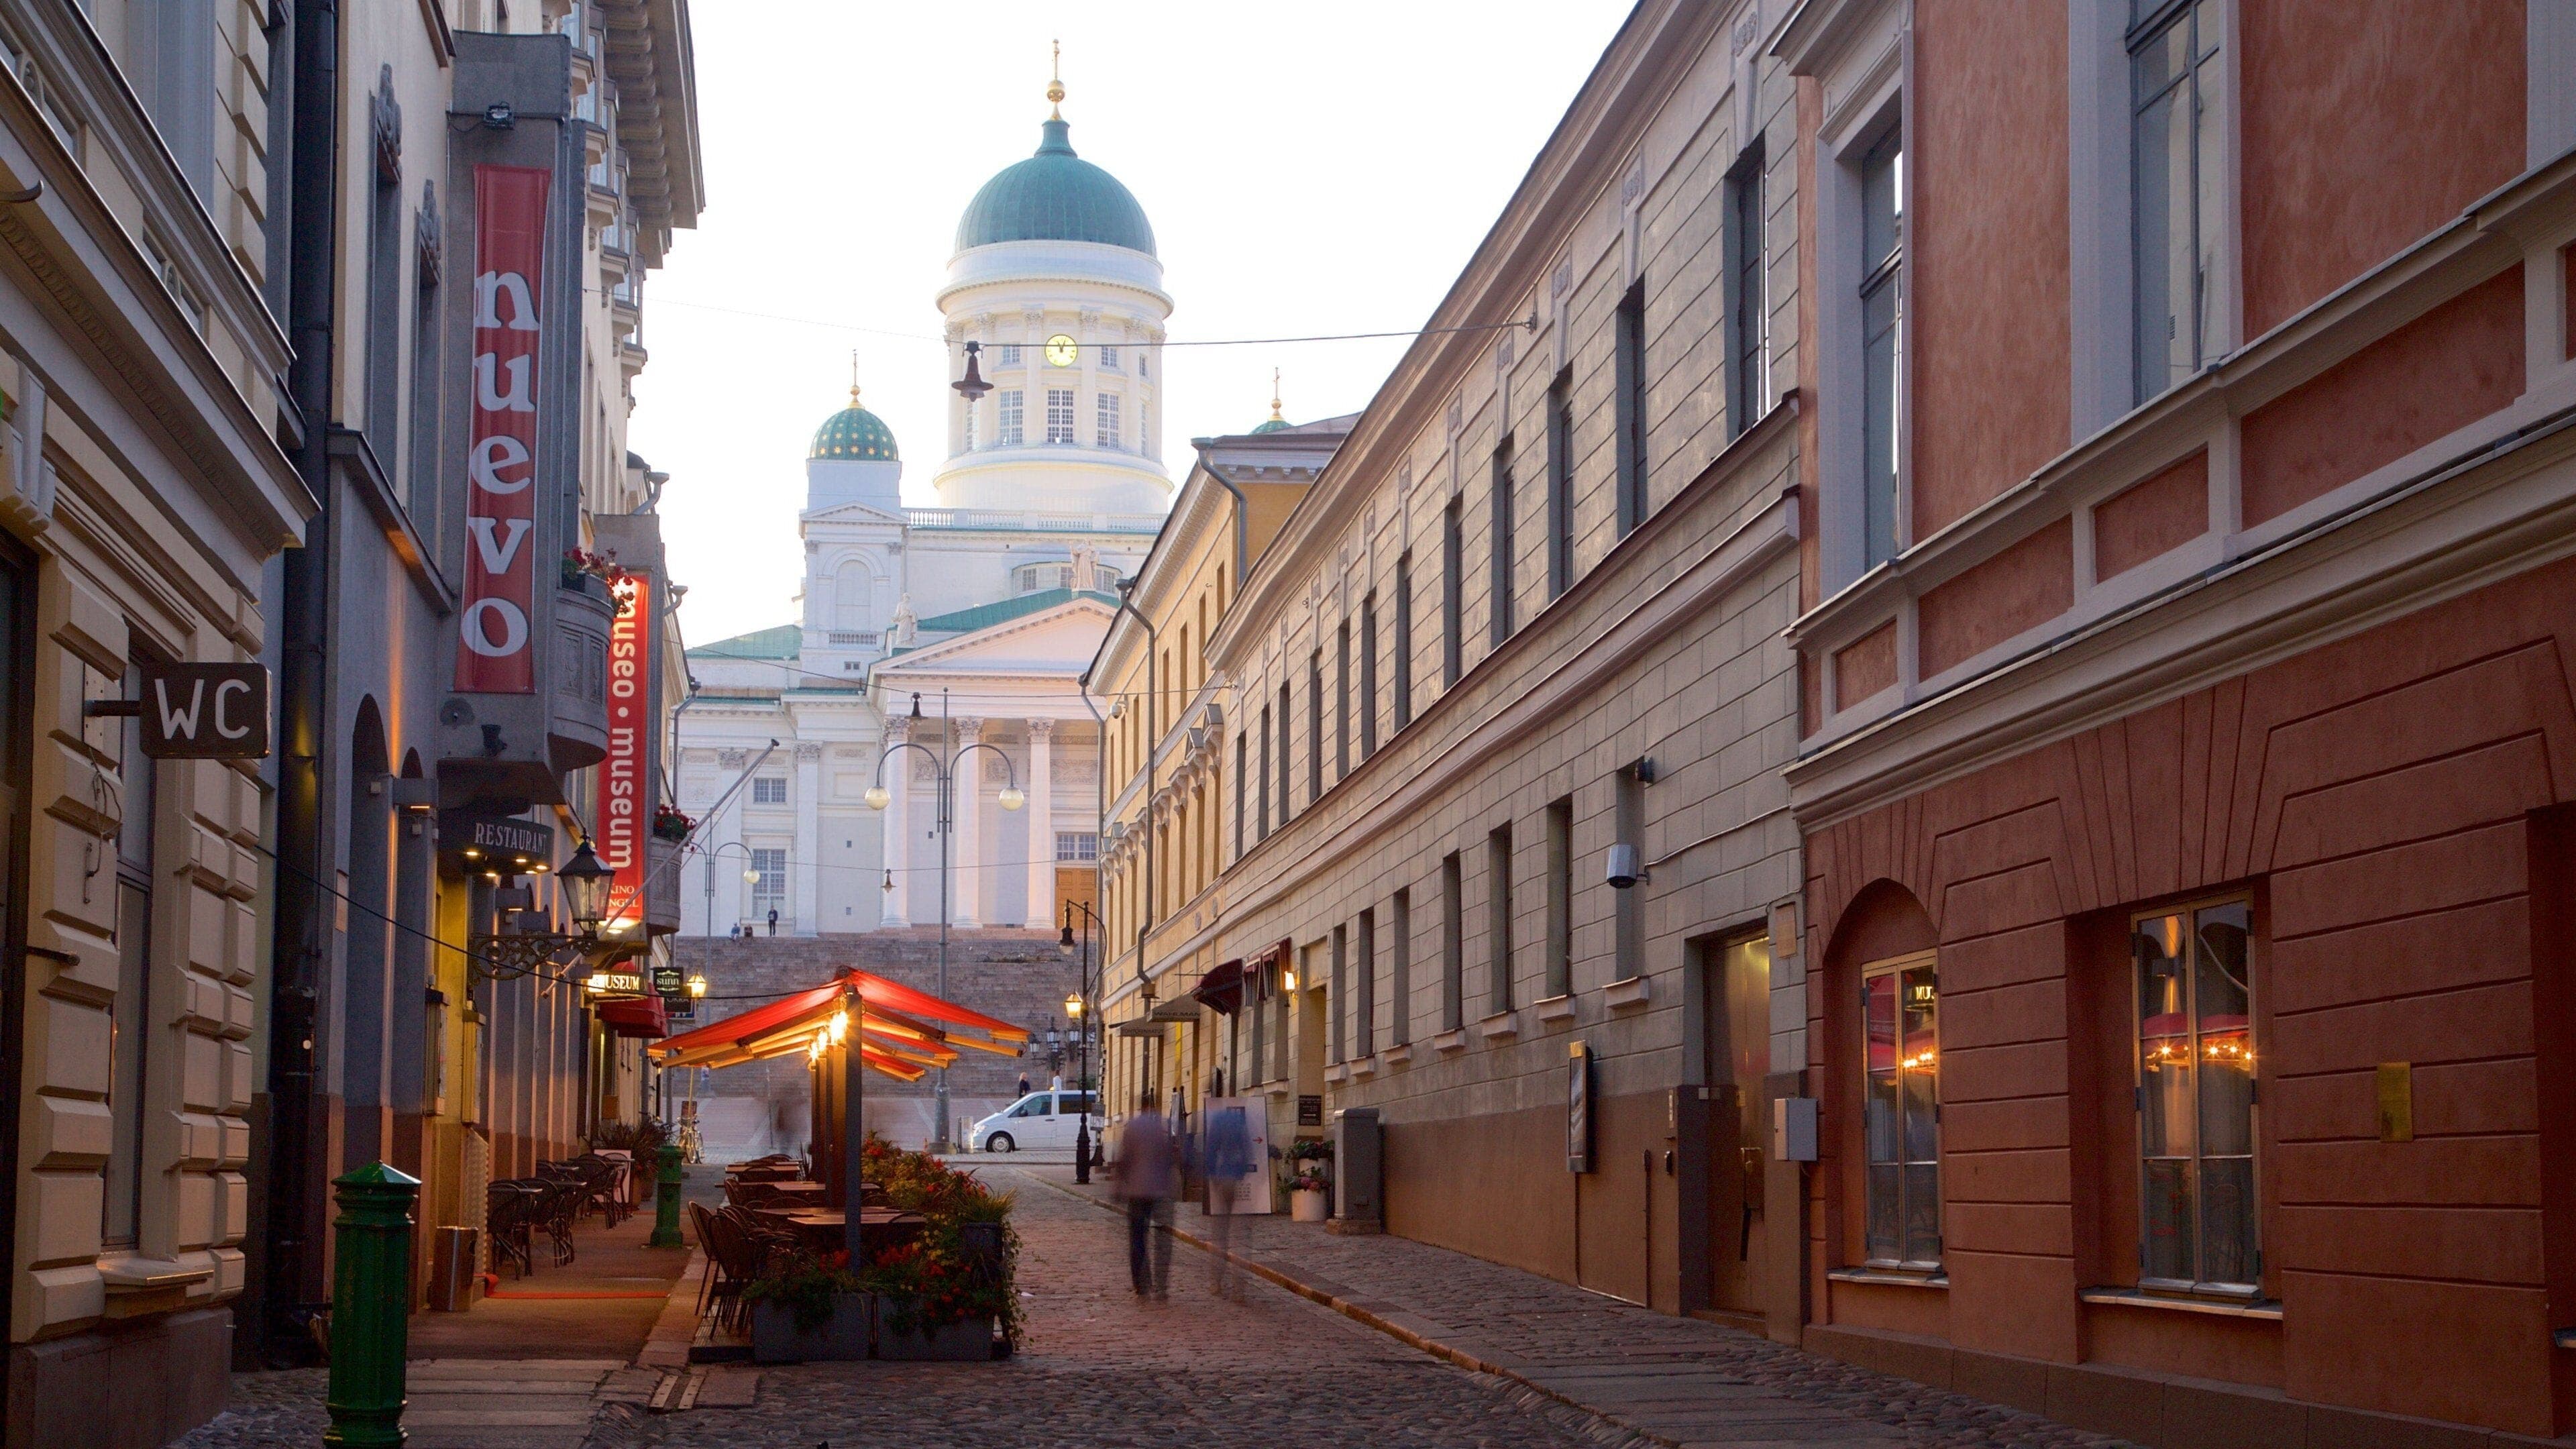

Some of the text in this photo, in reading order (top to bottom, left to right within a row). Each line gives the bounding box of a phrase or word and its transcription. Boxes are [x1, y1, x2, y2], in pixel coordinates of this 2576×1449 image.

[461, 270, 539, 657] nuevo
[154, 678, 252, 740] WC
[608, 728, 634, 869] museum
[474, 822, 547, 855] RESTAURANT
[657, 977, 680, 985] sunn
